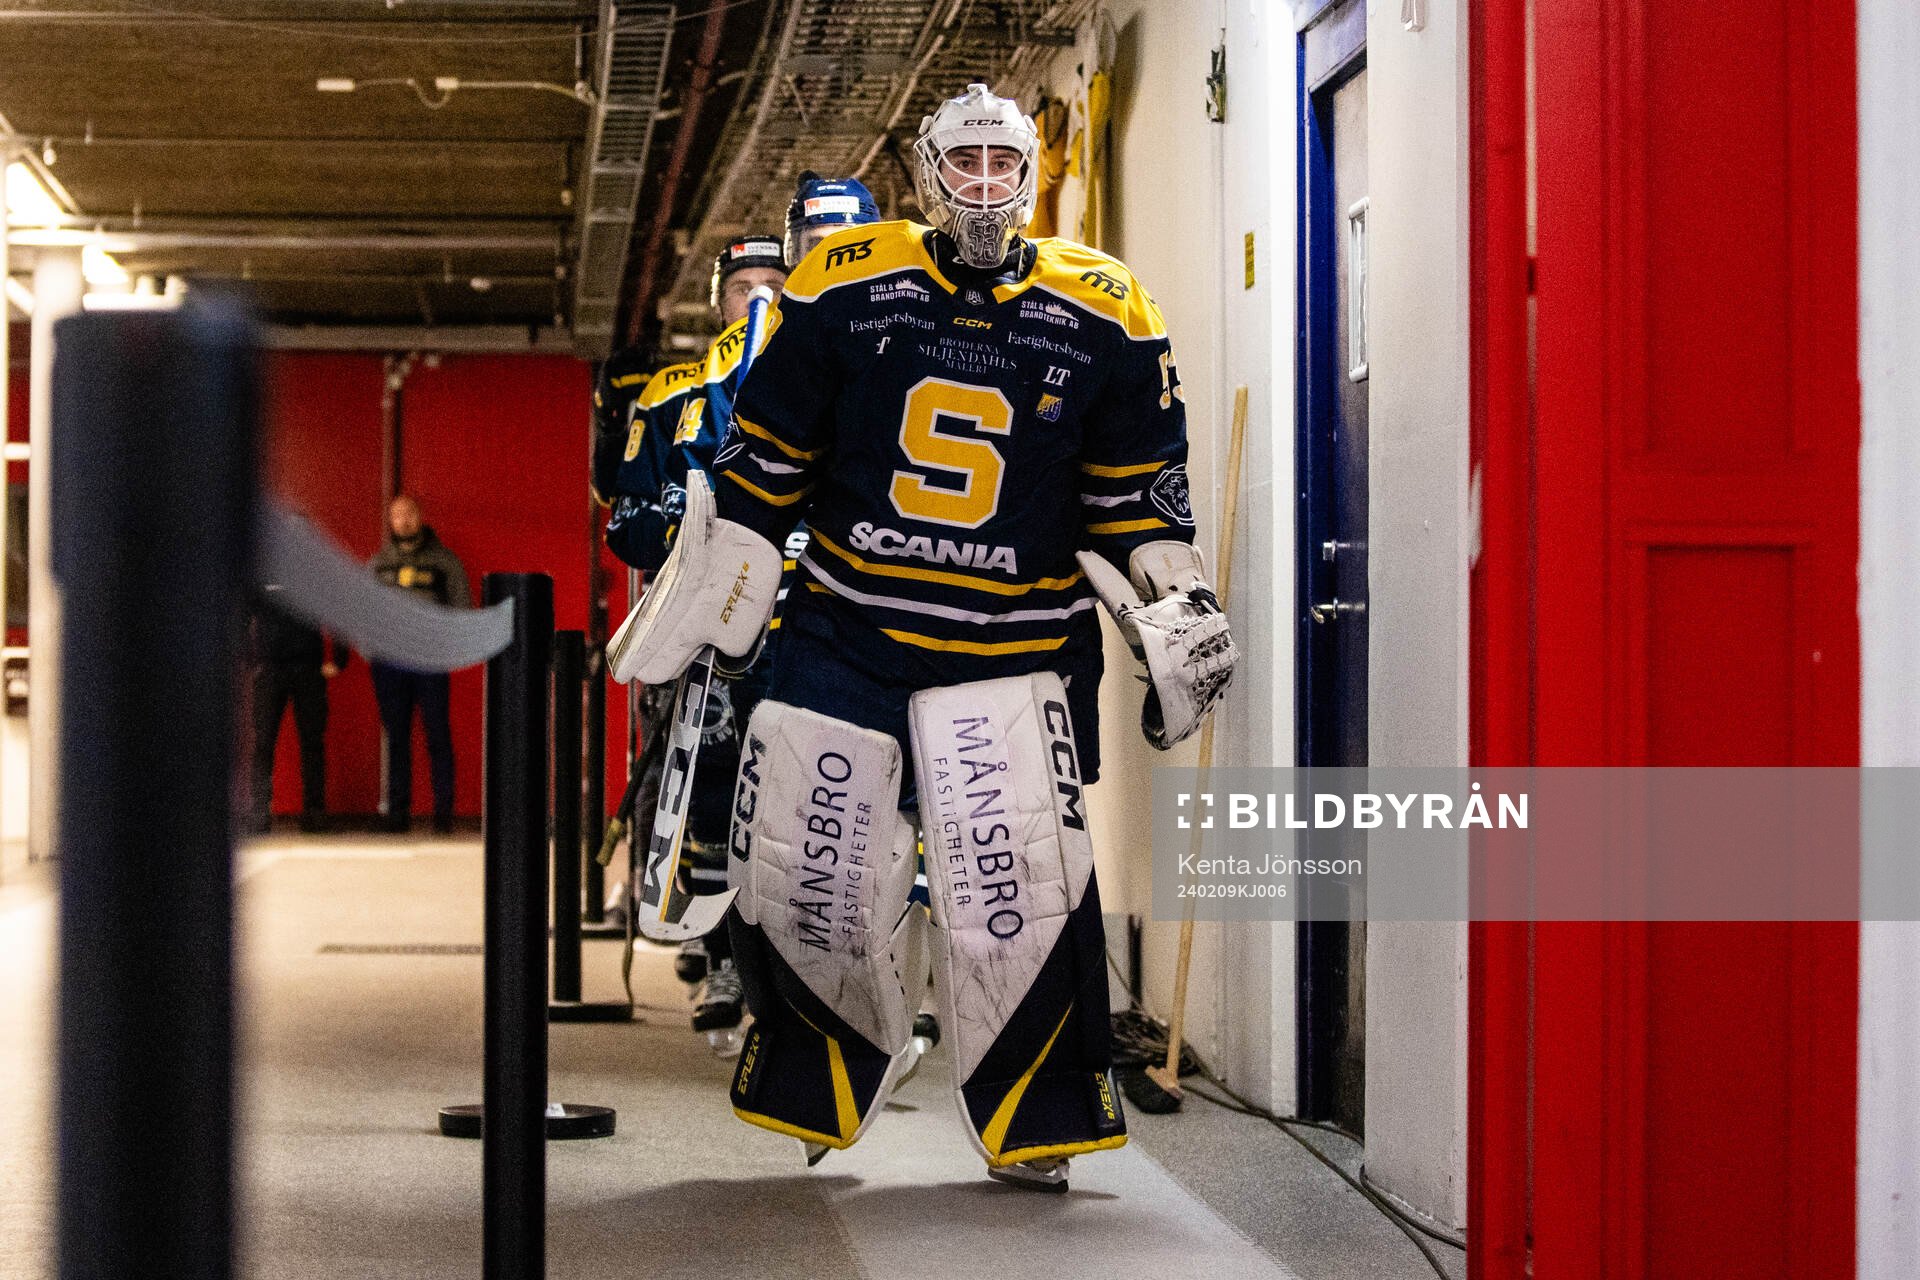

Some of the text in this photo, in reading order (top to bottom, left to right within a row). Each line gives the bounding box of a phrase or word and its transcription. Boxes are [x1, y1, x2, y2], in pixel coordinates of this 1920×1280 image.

[963, 119, 1004, 127] CCM
[967, 219, 1001, 262] 53
[870, 282, 894, 294] STÅL &
[870, 290, 930, 302] BRANDTEKNIK AB
[1038, 302, 1045, 311] &
[953, 317, 993, 330] CCM
[1019, 310, 1079, 330] BRANDTEKNIK AB
[918, 343, 1018, 371] SILJENDAHLS
[1042, 365, 1071, 387] LT
[624, 419, 646, 462] 8
[888, 375, 1015, 530] S
[849, 521, 1018, 575] SCANIA
[1043, 699, 1085, 832] CCM
[731, 732, 767, 863] CCM
[932, 757, 972, 907] FASTIGHETER
[952, 716, 1024, 939] MÅNSBRO
[787, 751, 852, 953] MÅNSBRO
[842, 801, 873, 934] FASTIGHETER
